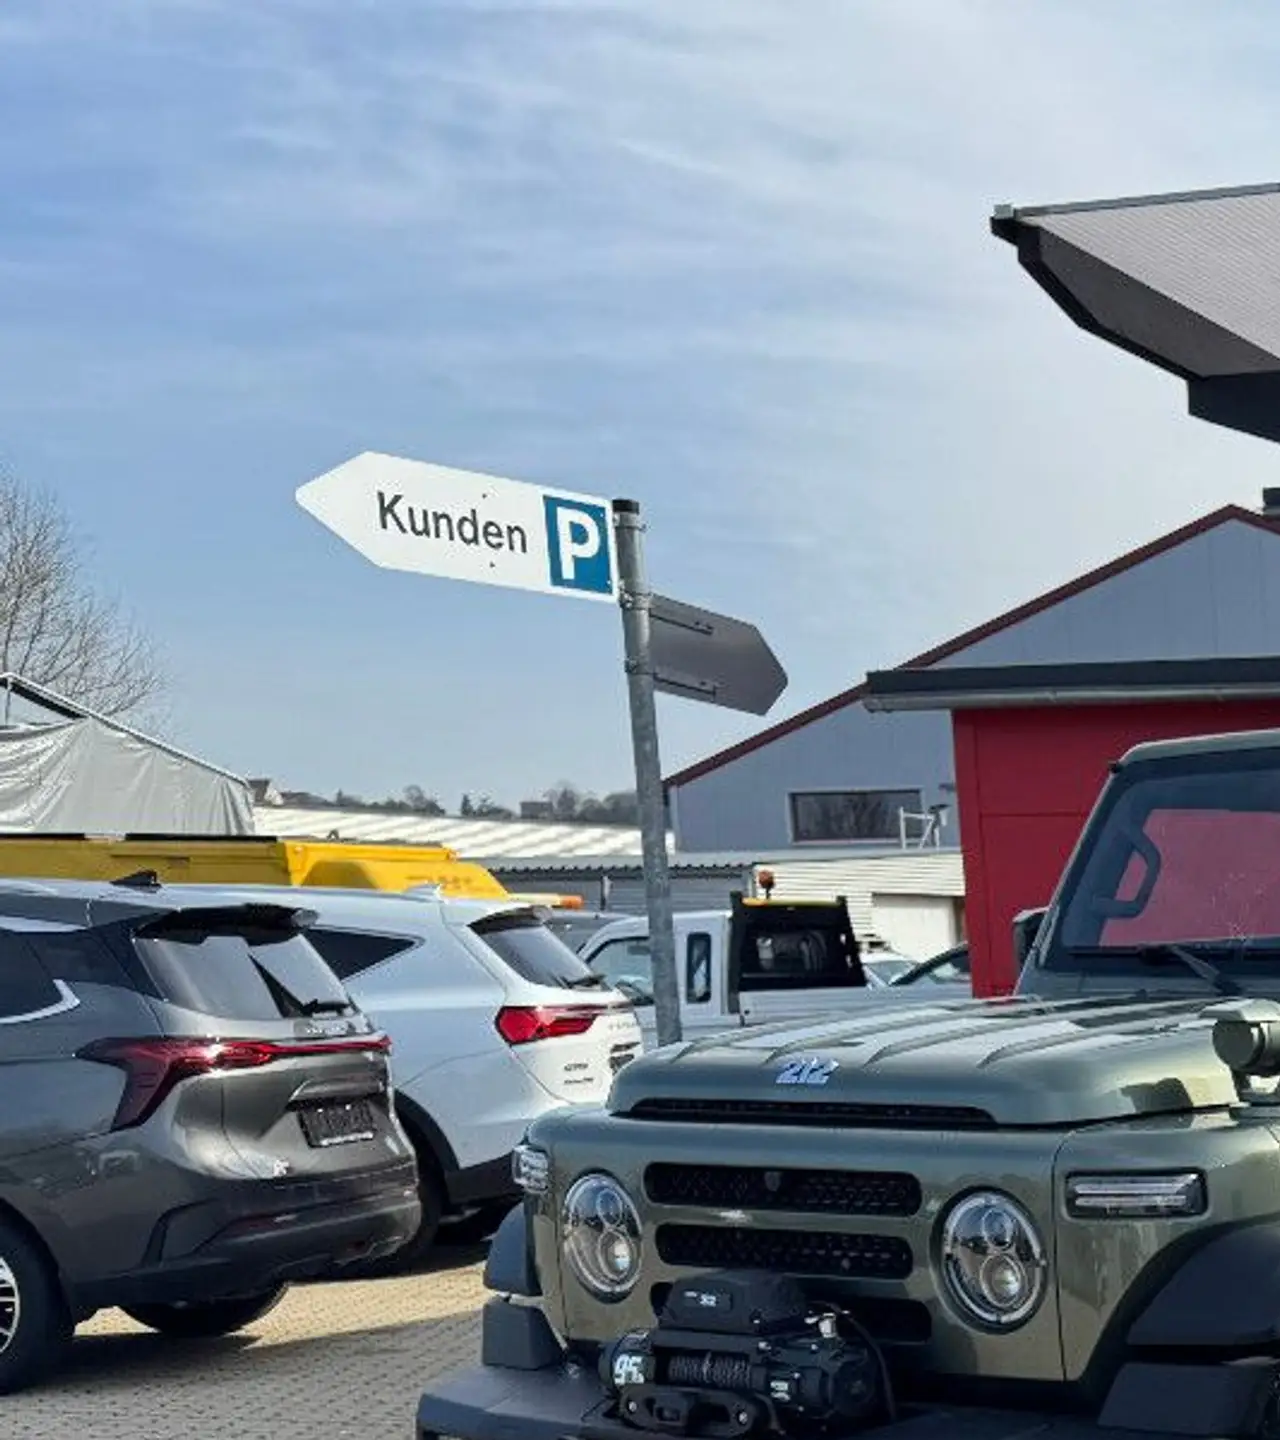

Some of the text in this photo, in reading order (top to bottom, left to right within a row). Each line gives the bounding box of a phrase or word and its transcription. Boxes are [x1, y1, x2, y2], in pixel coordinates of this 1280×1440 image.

[377, 491, 600, 579] Kunden P
[775, 1056, 839, 1084] 212
